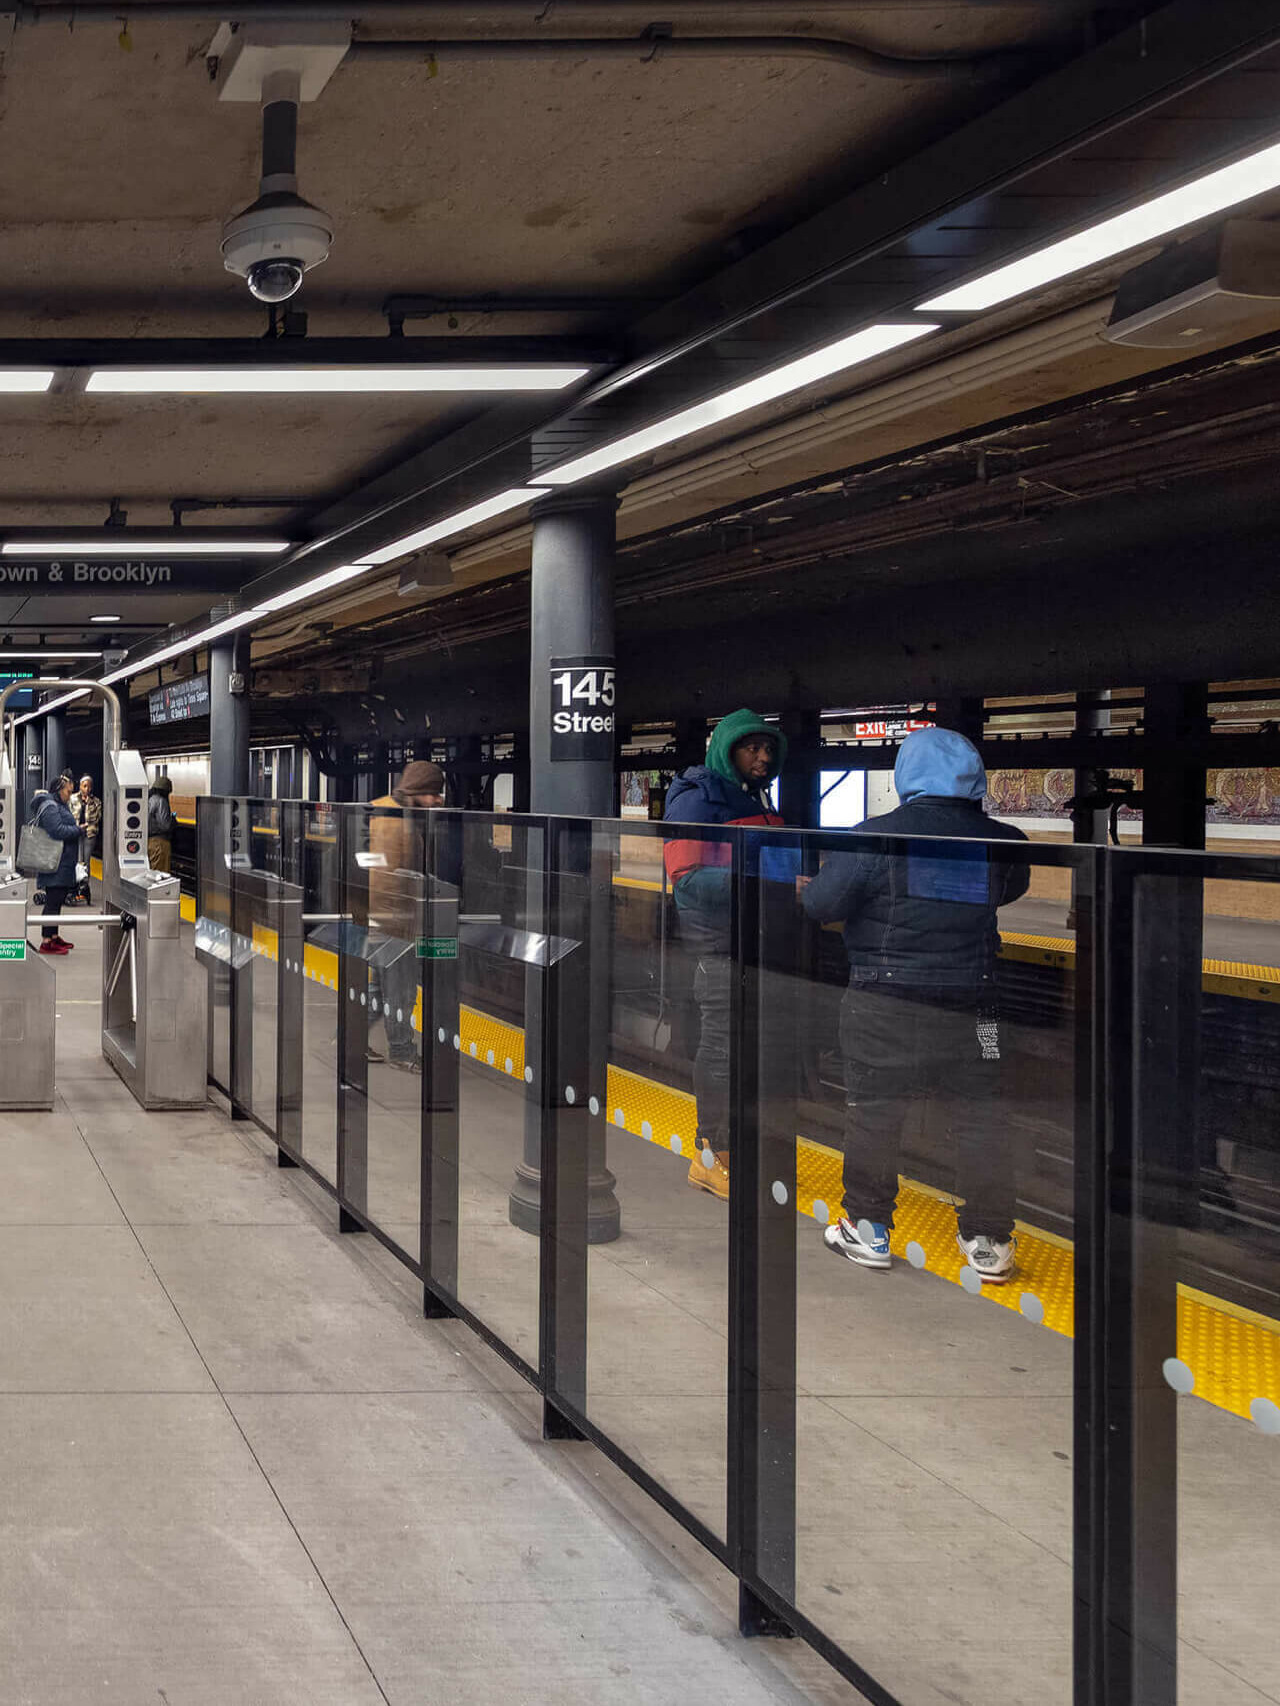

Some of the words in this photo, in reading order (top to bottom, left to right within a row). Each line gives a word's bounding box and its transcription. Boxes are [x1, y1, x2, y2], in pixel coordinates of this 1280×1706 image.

[48, 563, 64, 582] &
[73, 563, 172, 585] Brooklyn
[553, 671, 615, 707] 145
